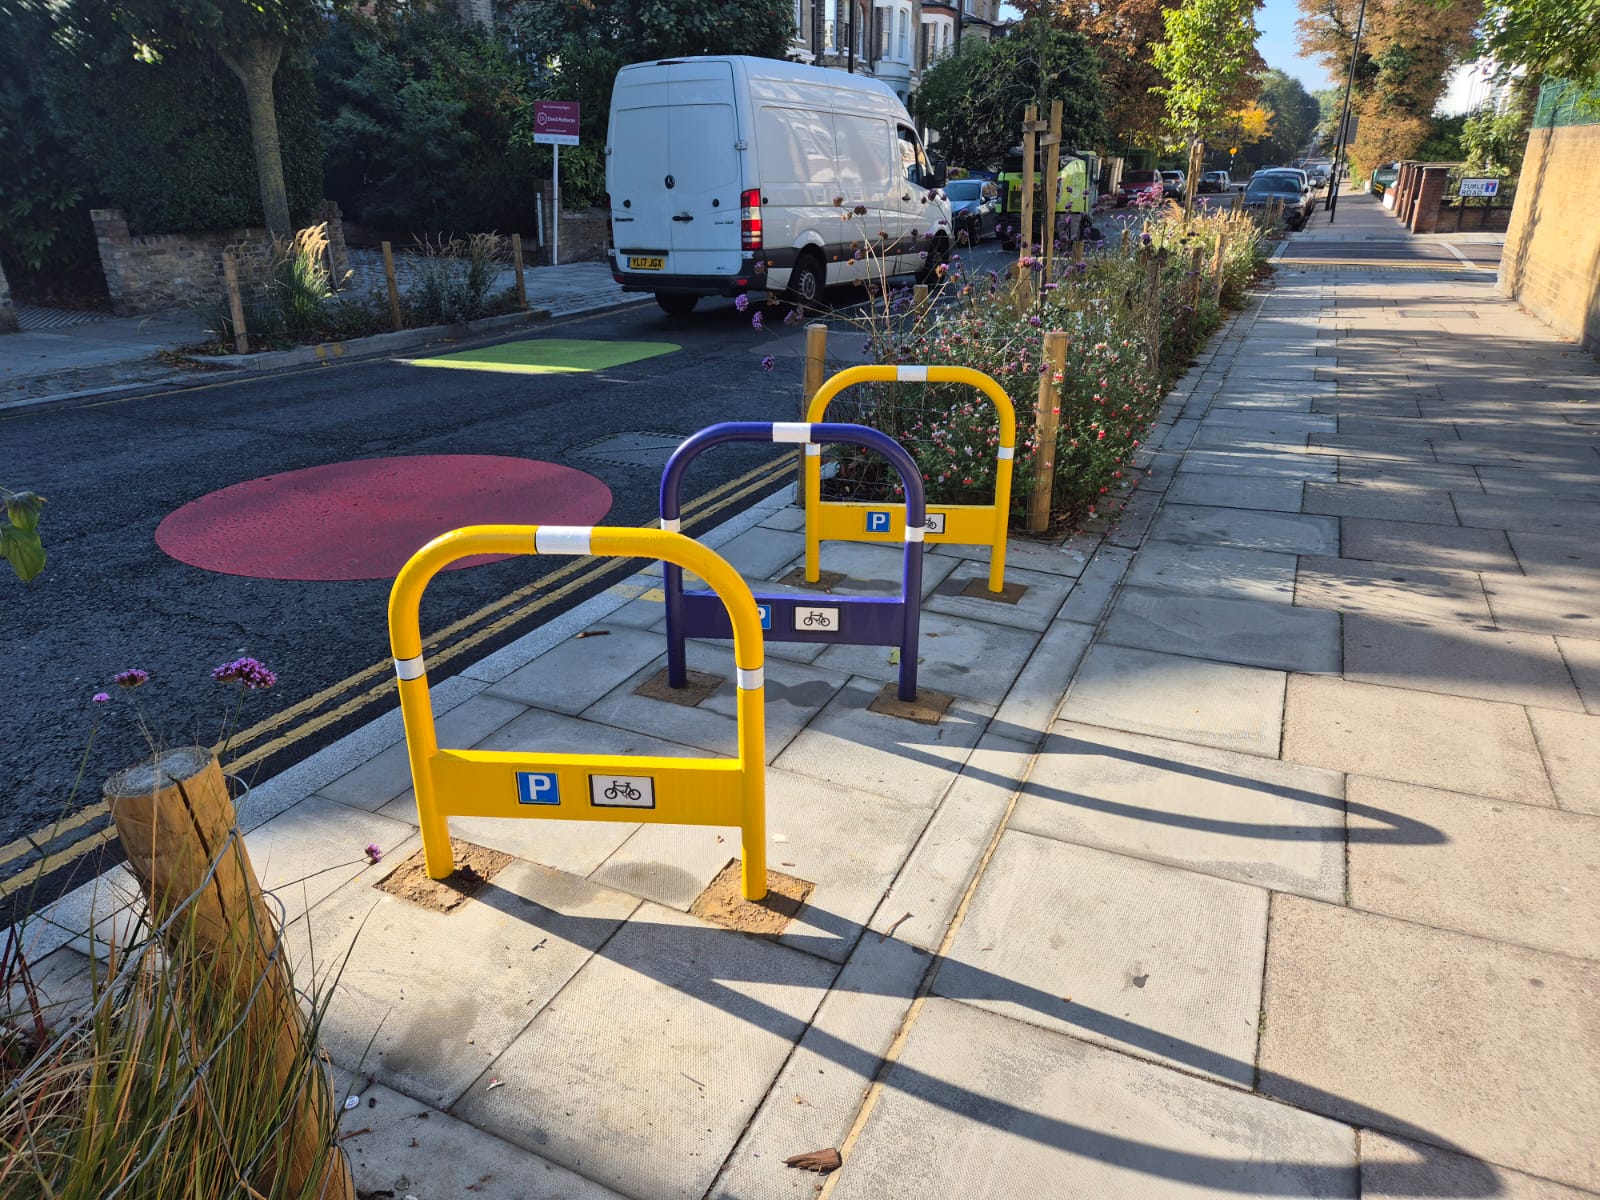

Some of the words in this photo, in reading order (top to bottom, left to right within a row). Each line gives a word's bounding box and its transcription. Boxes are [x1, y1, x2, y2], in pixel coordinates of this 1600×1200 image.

[632, 258, 647, 268] YL17
[648, 258, 662, 268] JGX
[872, 513, 886, 530] P
[528, 774, 551, 800] P
